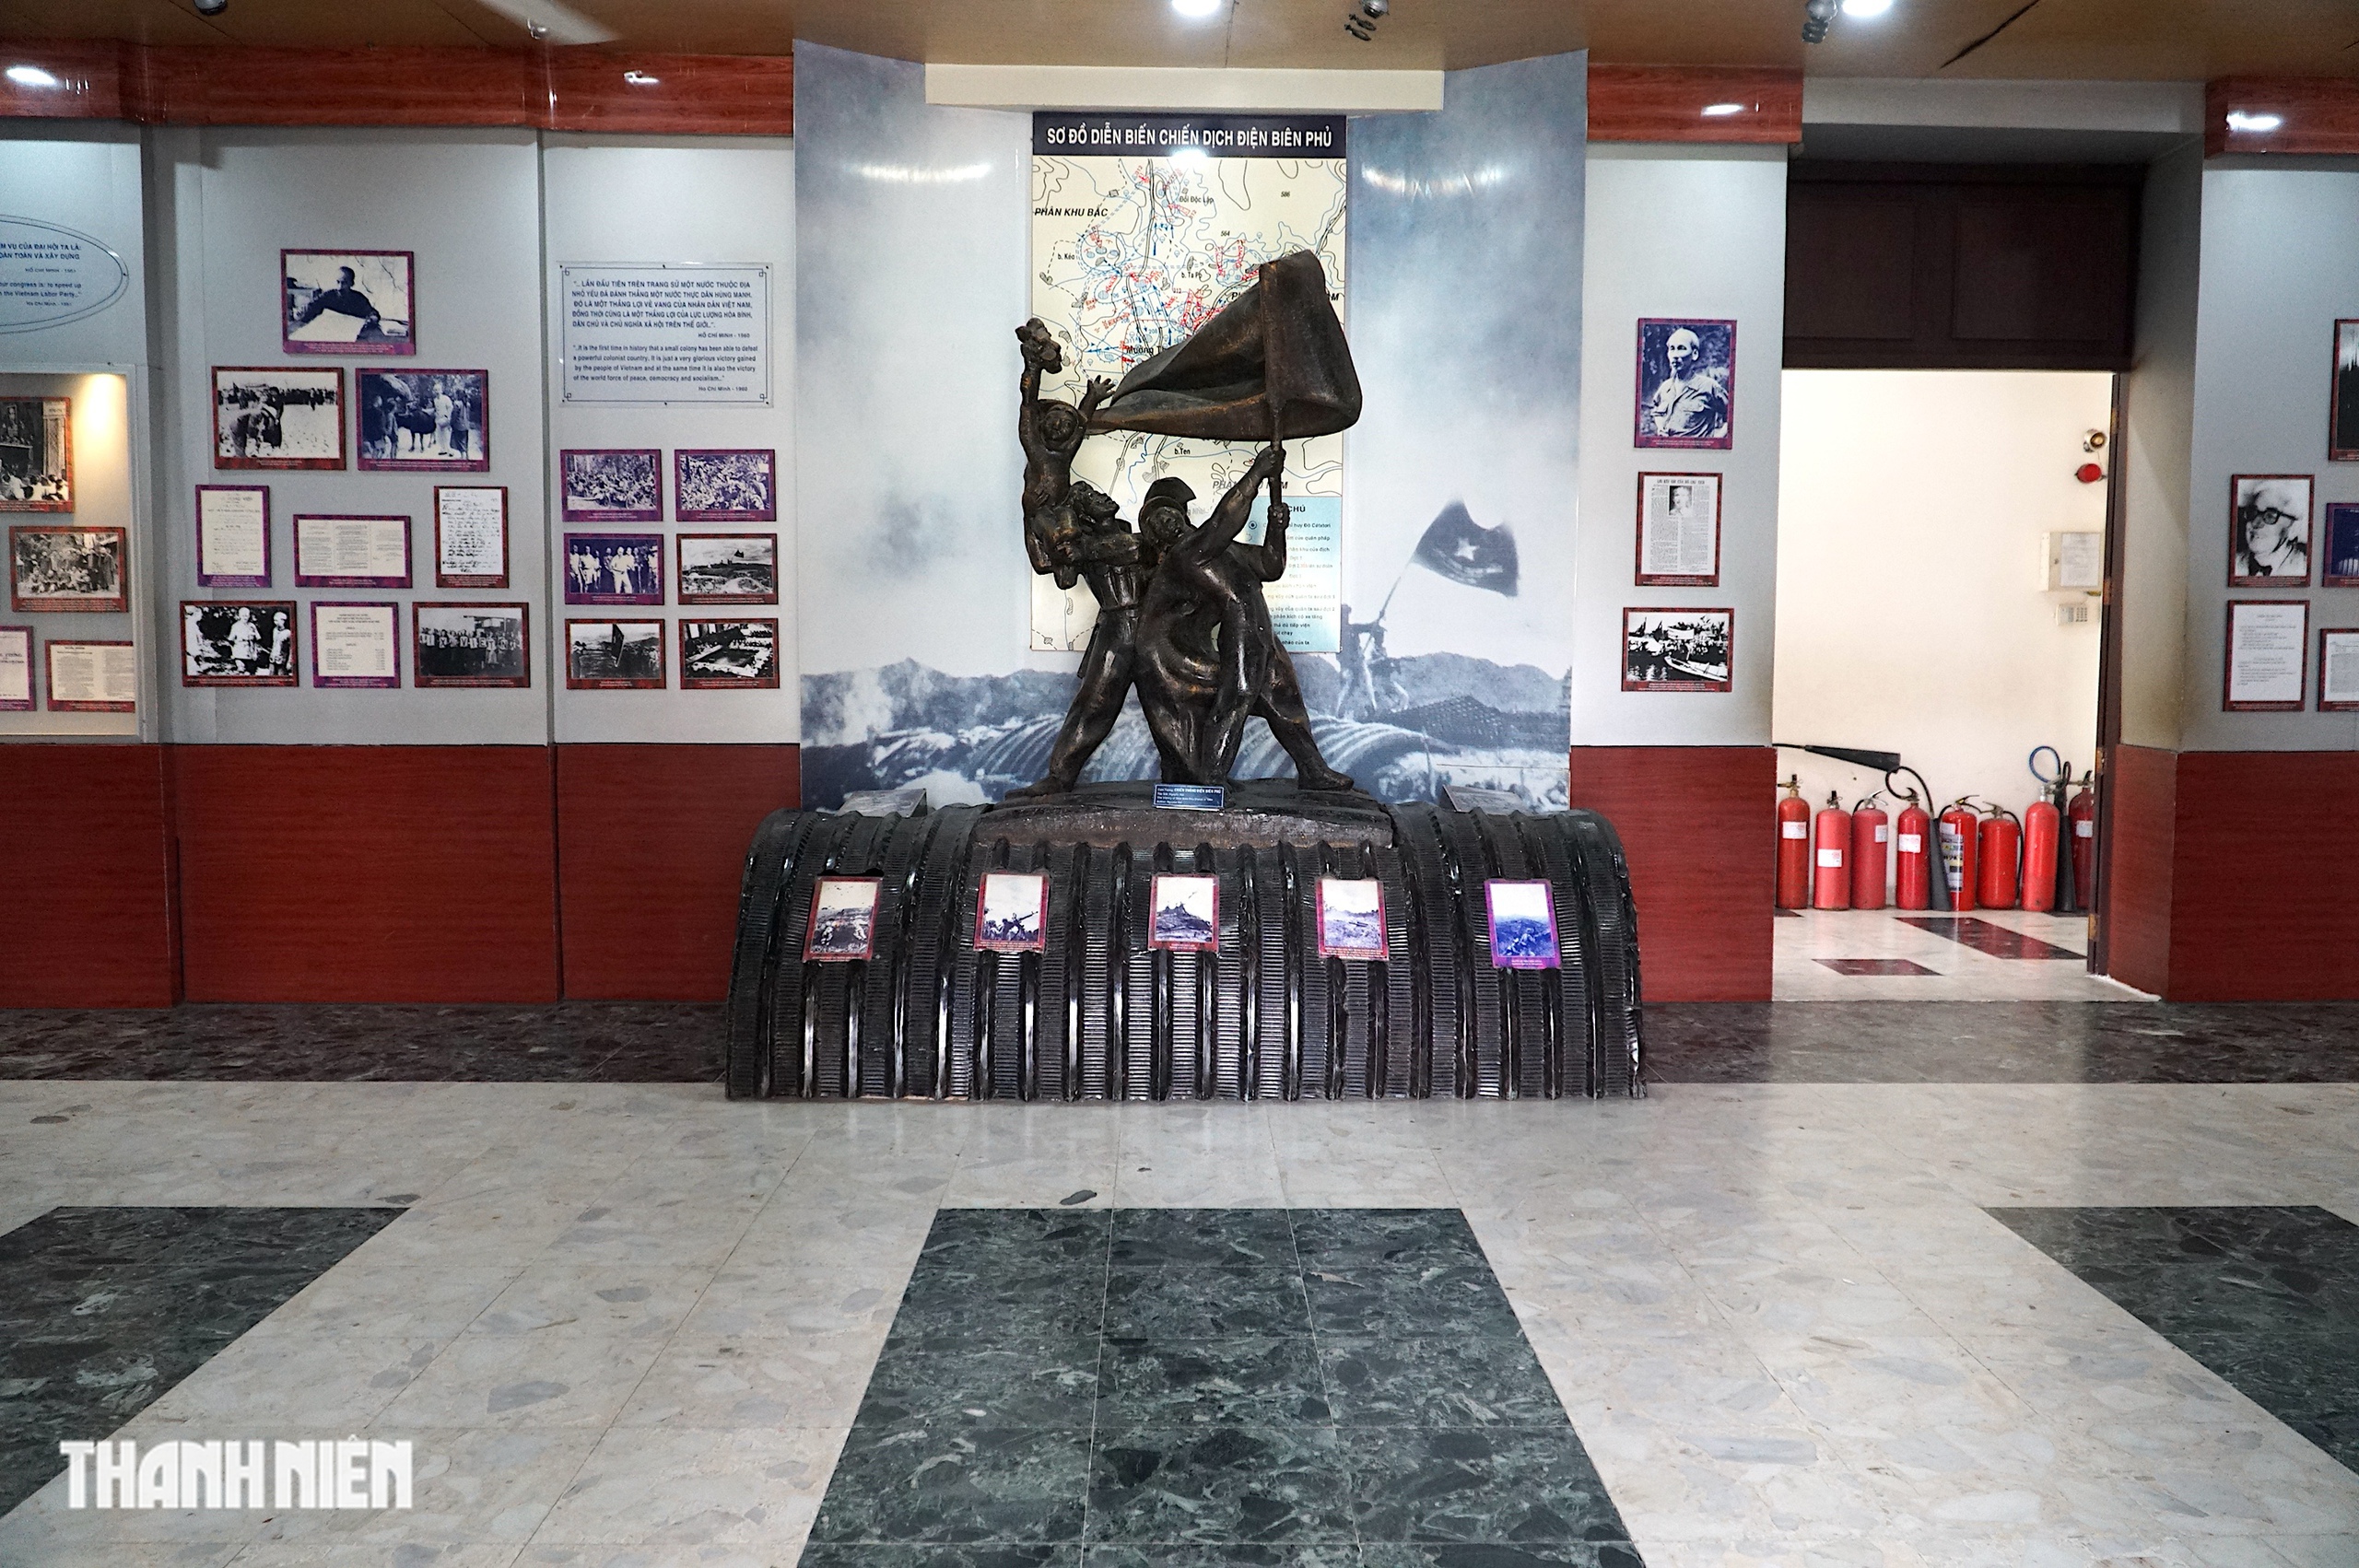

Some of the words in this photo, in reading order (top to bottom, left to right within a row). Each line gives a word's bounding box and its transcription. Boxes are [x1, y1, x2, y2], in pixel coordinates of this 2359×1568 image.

[1047, 127, 1065, 145] SƠ
[1068, 122, 1086, 145] ĐỒ
[1091, 121, 1121, 145] DIỄN
[1125, 123, 1156, 145] BIẾN
[1158, 123, 1199, 145] CHIẾN
[1203, 131, 1234, 148] DỊCH
[1237, 127, 1268, 149] ĐIỆN
[1271, 128, 1302, 146] BIÊN
[1306, 125, 1332, 147] PHỦ
[1035, 205, 1062, 216] PHÂN
[1064, 208, 1086, 216] KHU
